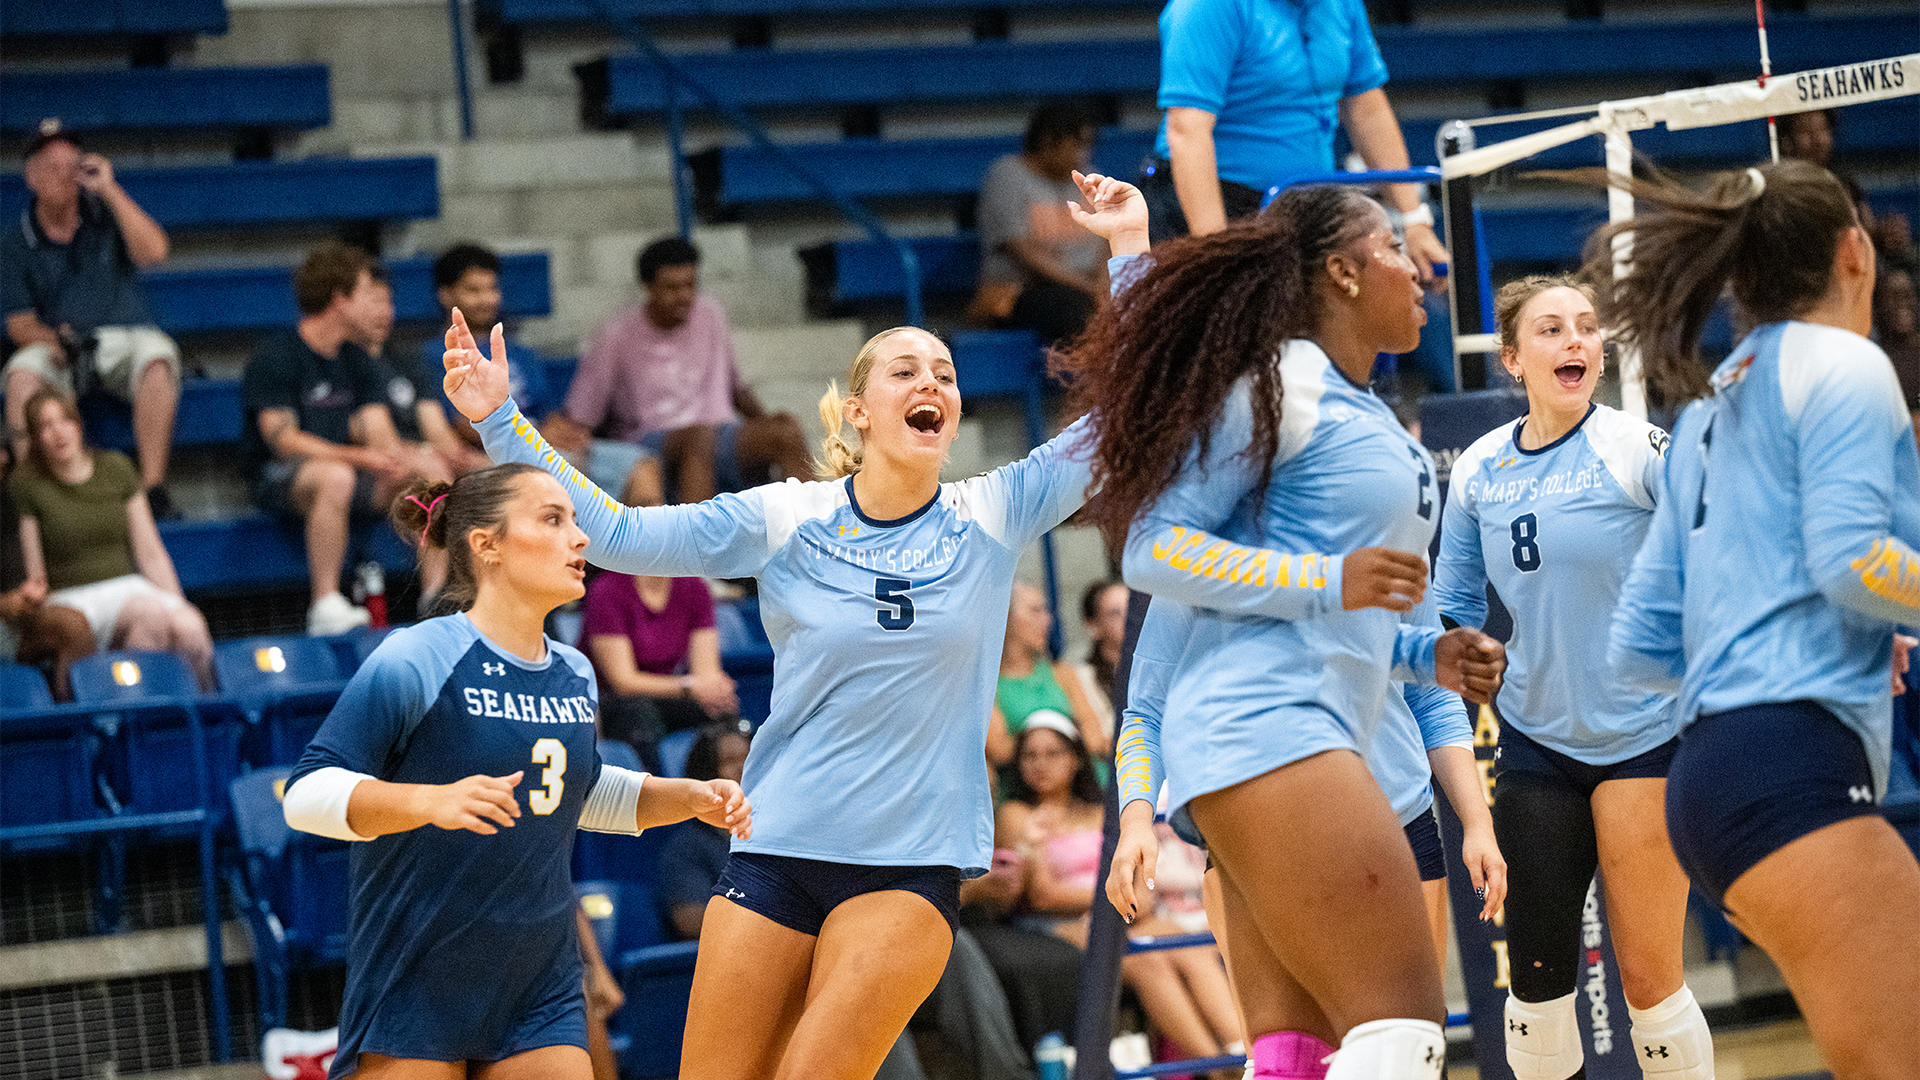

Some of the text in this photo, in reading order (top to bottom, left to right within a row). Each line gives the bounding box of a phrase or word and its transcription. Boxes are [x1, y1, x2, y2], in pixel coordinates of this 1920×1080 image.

[1796, 60, 1904, 101] SEAHAWKS
[1481, 476, 1539, 502] MARY'S
[902, 533, 967, 572] COLLEG
[1510, 510, 1542, 574] 8
[874, 576, 917, 633] 5
[463, 687, 595, 724] SEAHAWKS
[529, 738, 568, 816] 3
